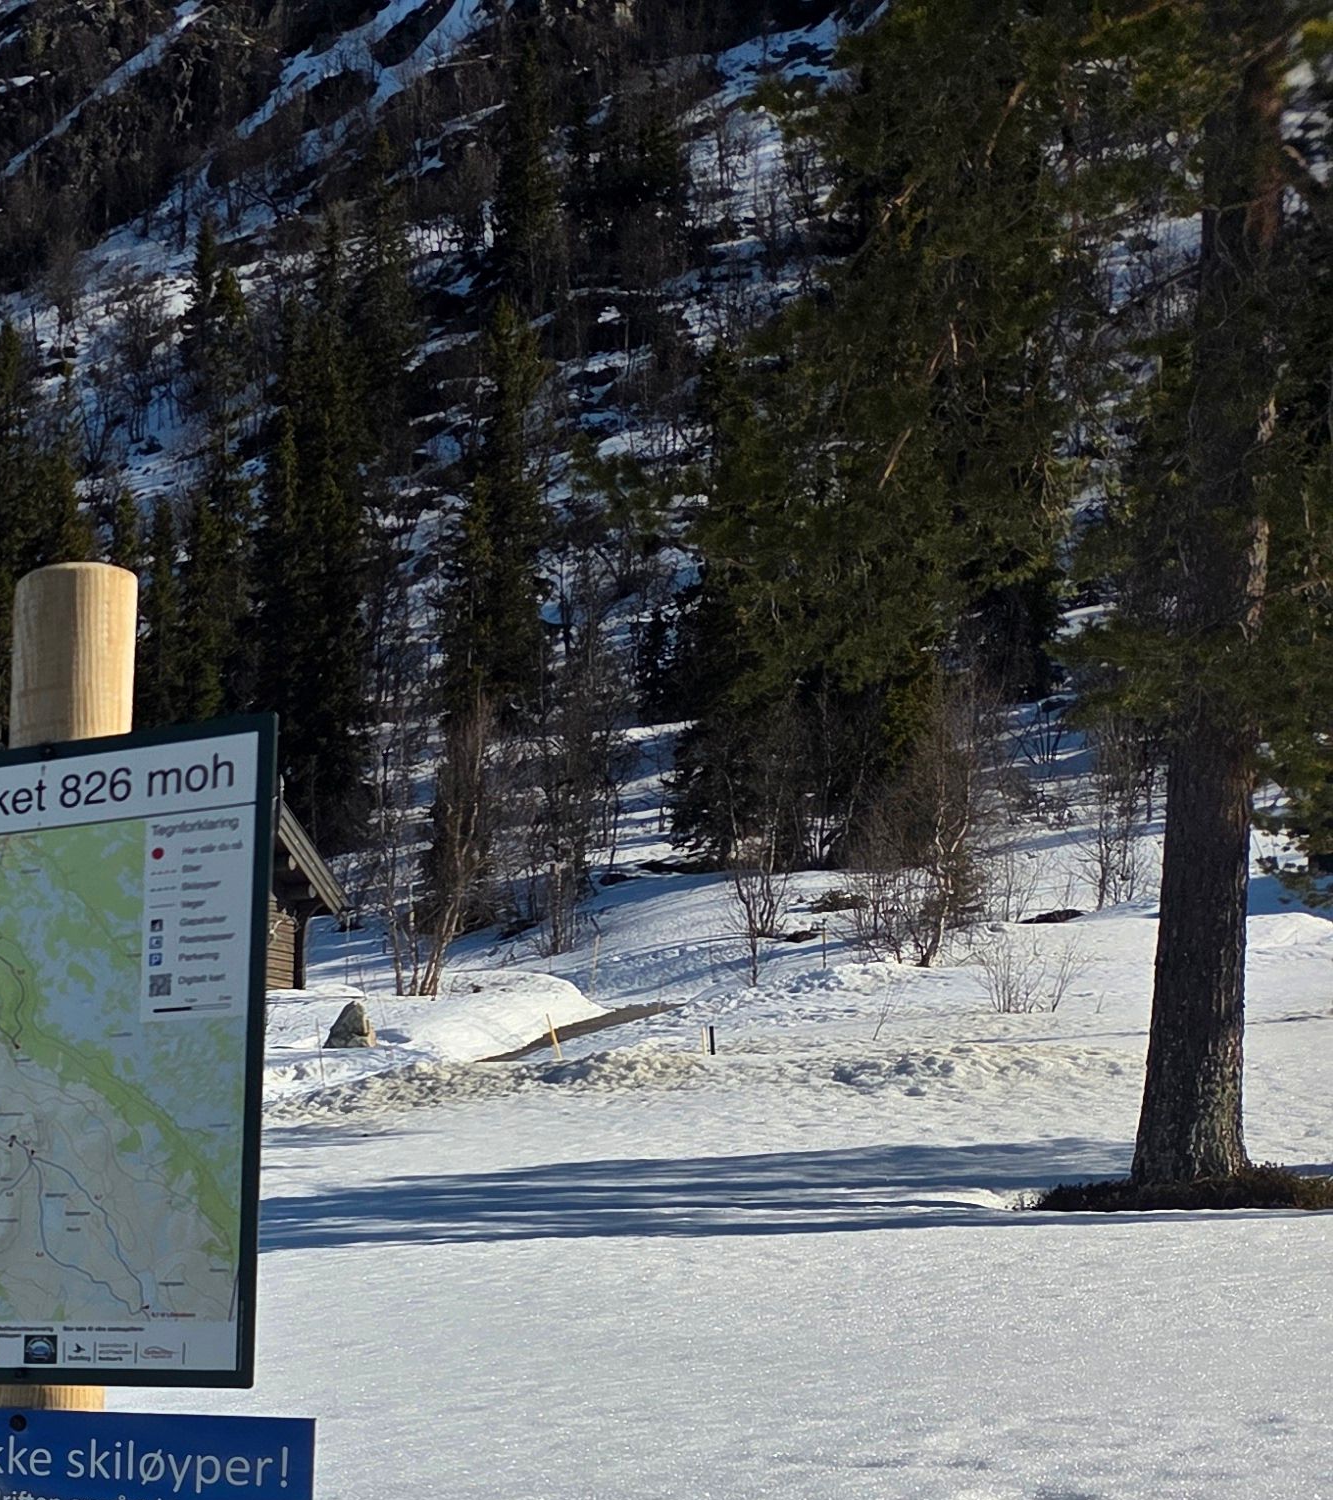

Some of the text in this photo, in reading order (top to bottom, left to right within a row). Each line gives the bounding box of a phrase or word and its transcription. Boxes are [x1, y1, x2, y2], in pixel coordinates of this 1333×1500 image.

[59, 767, 133, 809] 826
[147, 752, 235, 798] moh
[66, 1438, 289, 1494] skiløyper!
